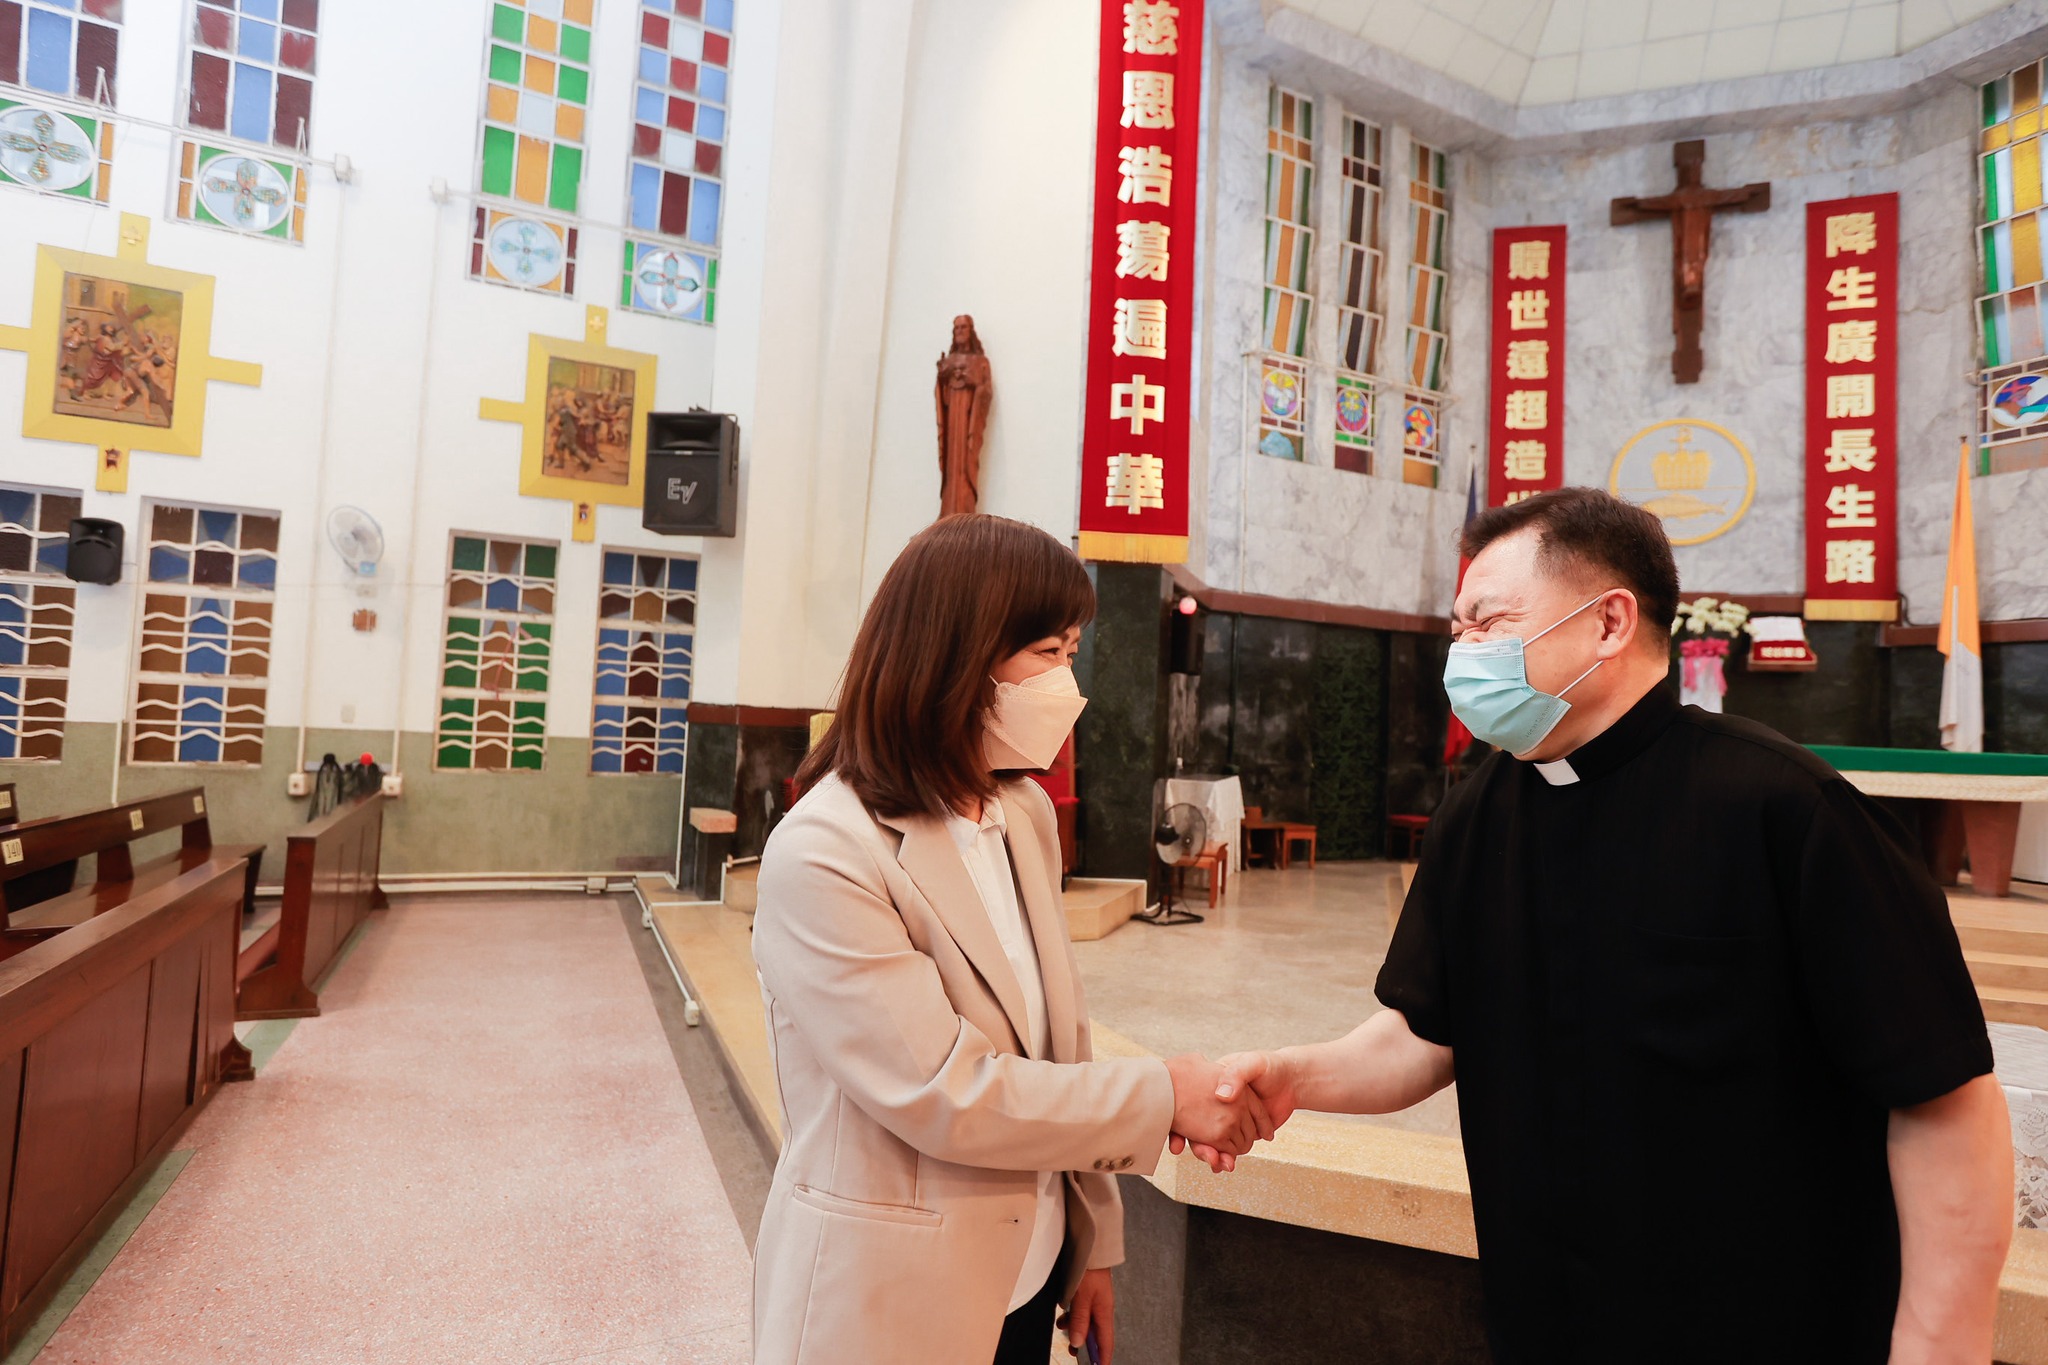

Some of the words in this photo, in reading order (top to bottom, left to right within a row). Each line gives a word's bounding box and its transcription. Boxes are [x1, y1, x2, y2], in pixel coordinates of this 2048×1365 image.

[1105, 0, 1180, 515] 慈恩浩蕩遍中華
[1503, 240, 1551, 507] 贖世遠超造
[1824, 211, 1878, 584] 降生廣開長生路
